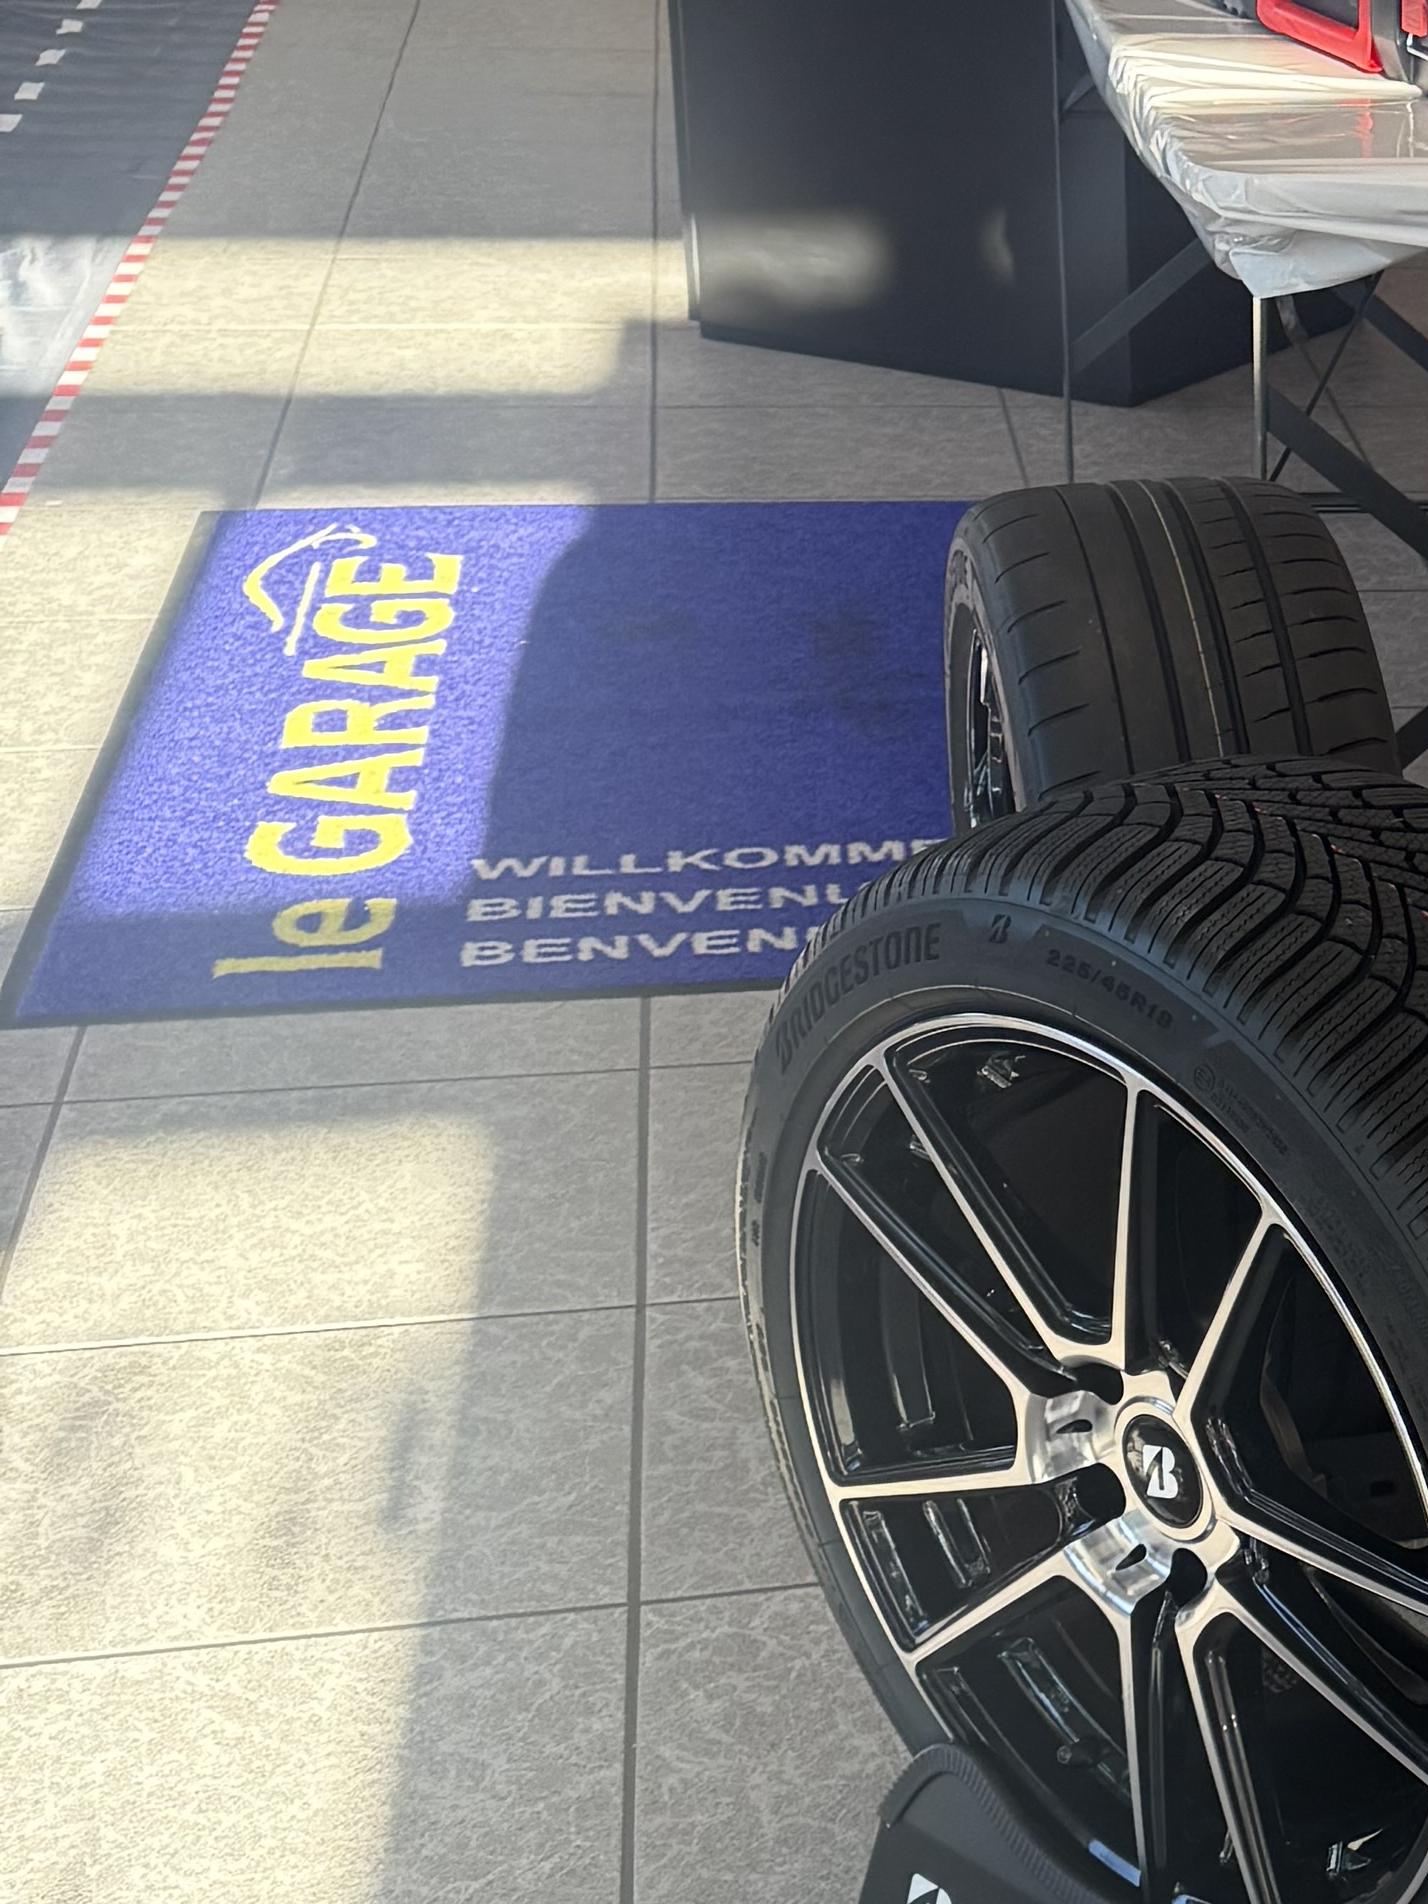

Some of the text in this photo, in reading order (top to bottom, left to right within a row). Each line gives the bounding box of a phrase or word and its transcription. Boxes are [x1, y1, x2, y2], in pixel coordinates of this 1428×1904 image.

[212, 552, 463, 980] le GARAGE
[461, 925, 820, 968] BENVEN
[775, 922, 943, 1074] BRIDGESTONE
